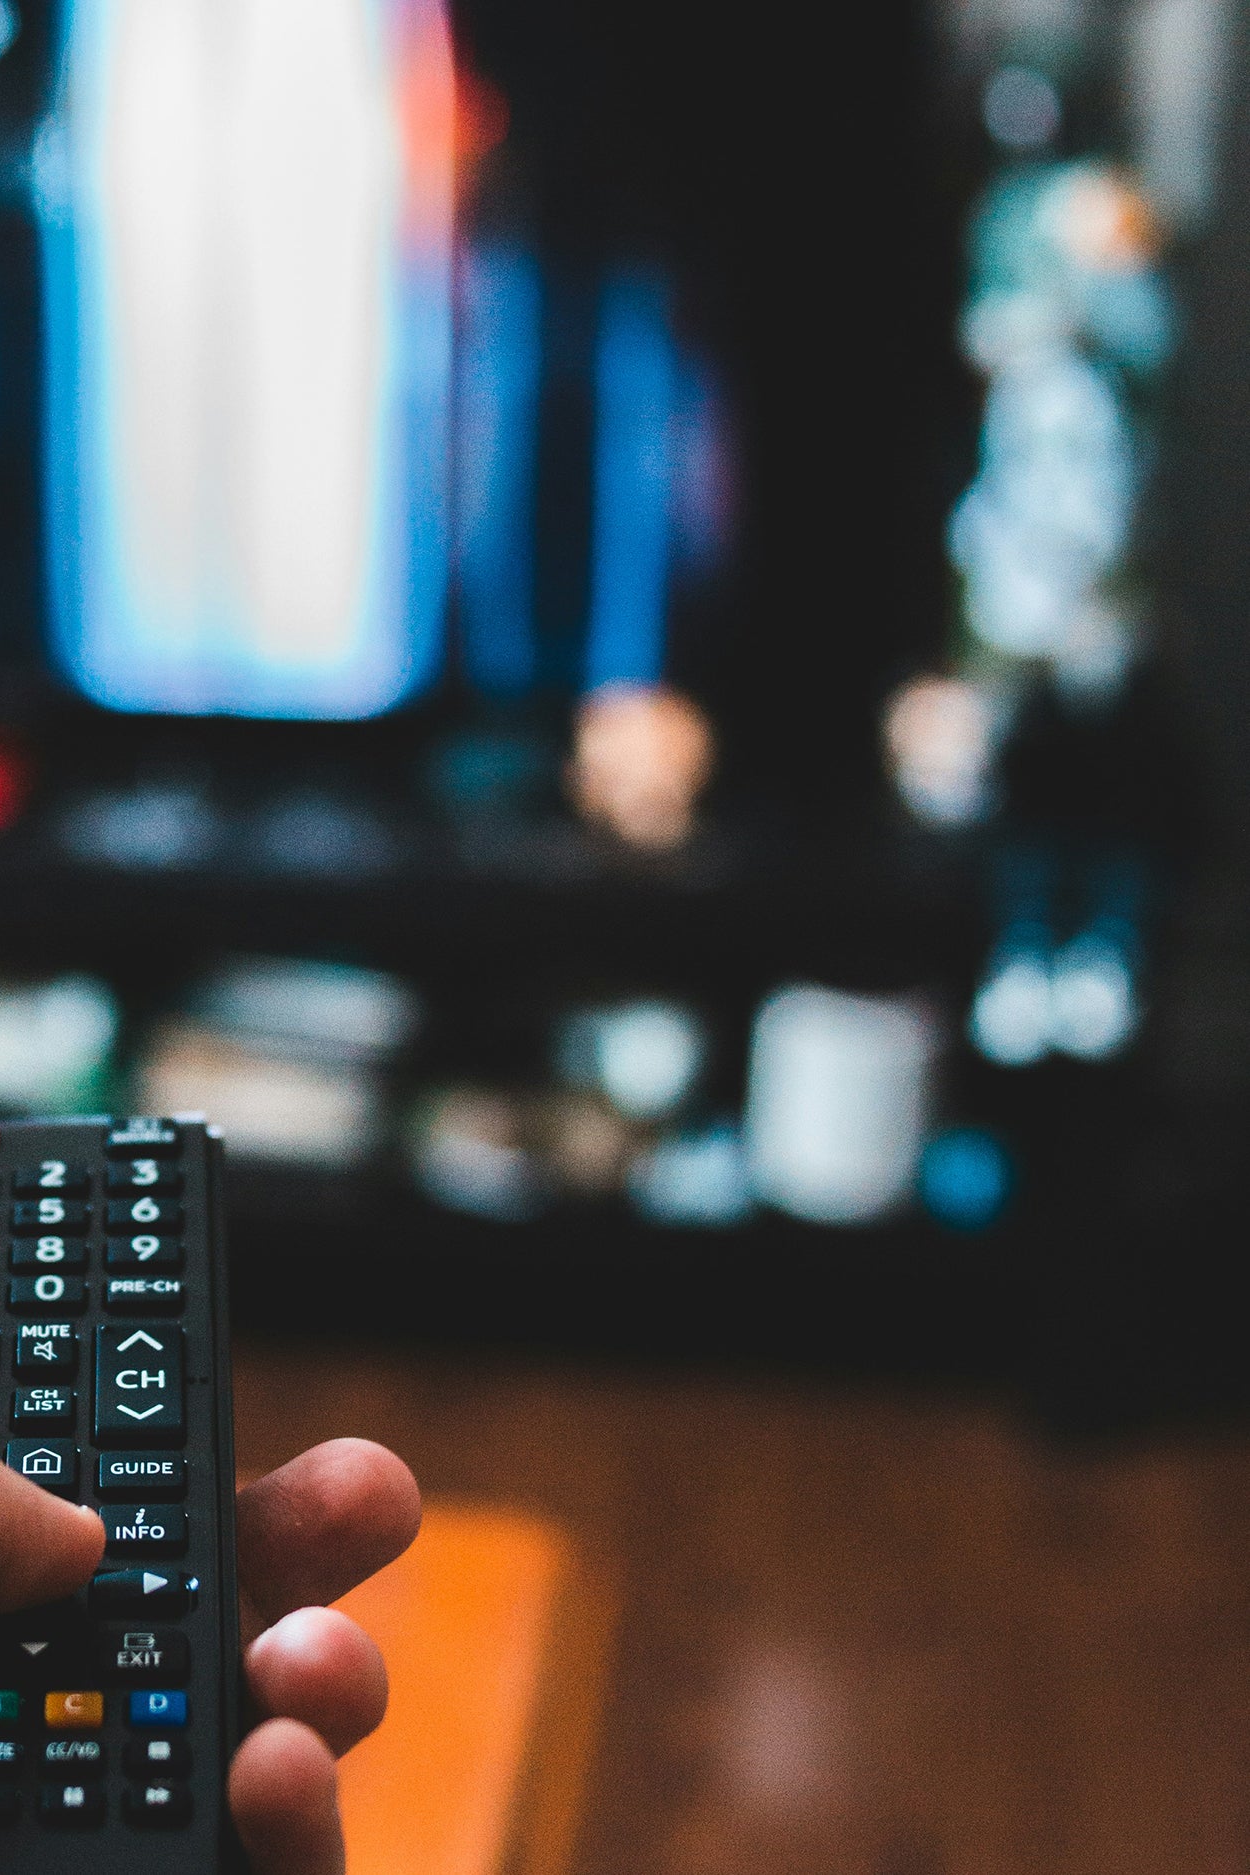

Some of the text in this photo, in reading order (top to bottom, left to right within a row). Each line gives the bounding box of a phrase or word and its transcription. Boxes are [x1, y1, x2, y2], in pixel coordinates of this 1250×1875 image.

[40, 1161, 66, 1187] 2
[131, 1159, 158, 1185] 3
[39, 1198, 65, 1224] 5
[131, 1197, 159, 1222] 6
[36, 1236, 64, 1262] 8
[131, 1235, 160, 1261] 9
[35, 1275, 64, 1300] 0
[110, 1280, 180, 1293] PRE-CH
[21, 1325, 70, 1338] MUTE
[115, 1370, 166, 1389] CH
[30, 1390, 58, 1399] CH
[23, 1400, 65, 1411] LIST
[110, 1462, 174, 1475] GUIDE
[115, 1526, 165, 1540] INFO
[117, 1651, 162, 1667] EXIT
[64, 1693, 83, 1714] C
[149, 1694, 168, 1713] D
